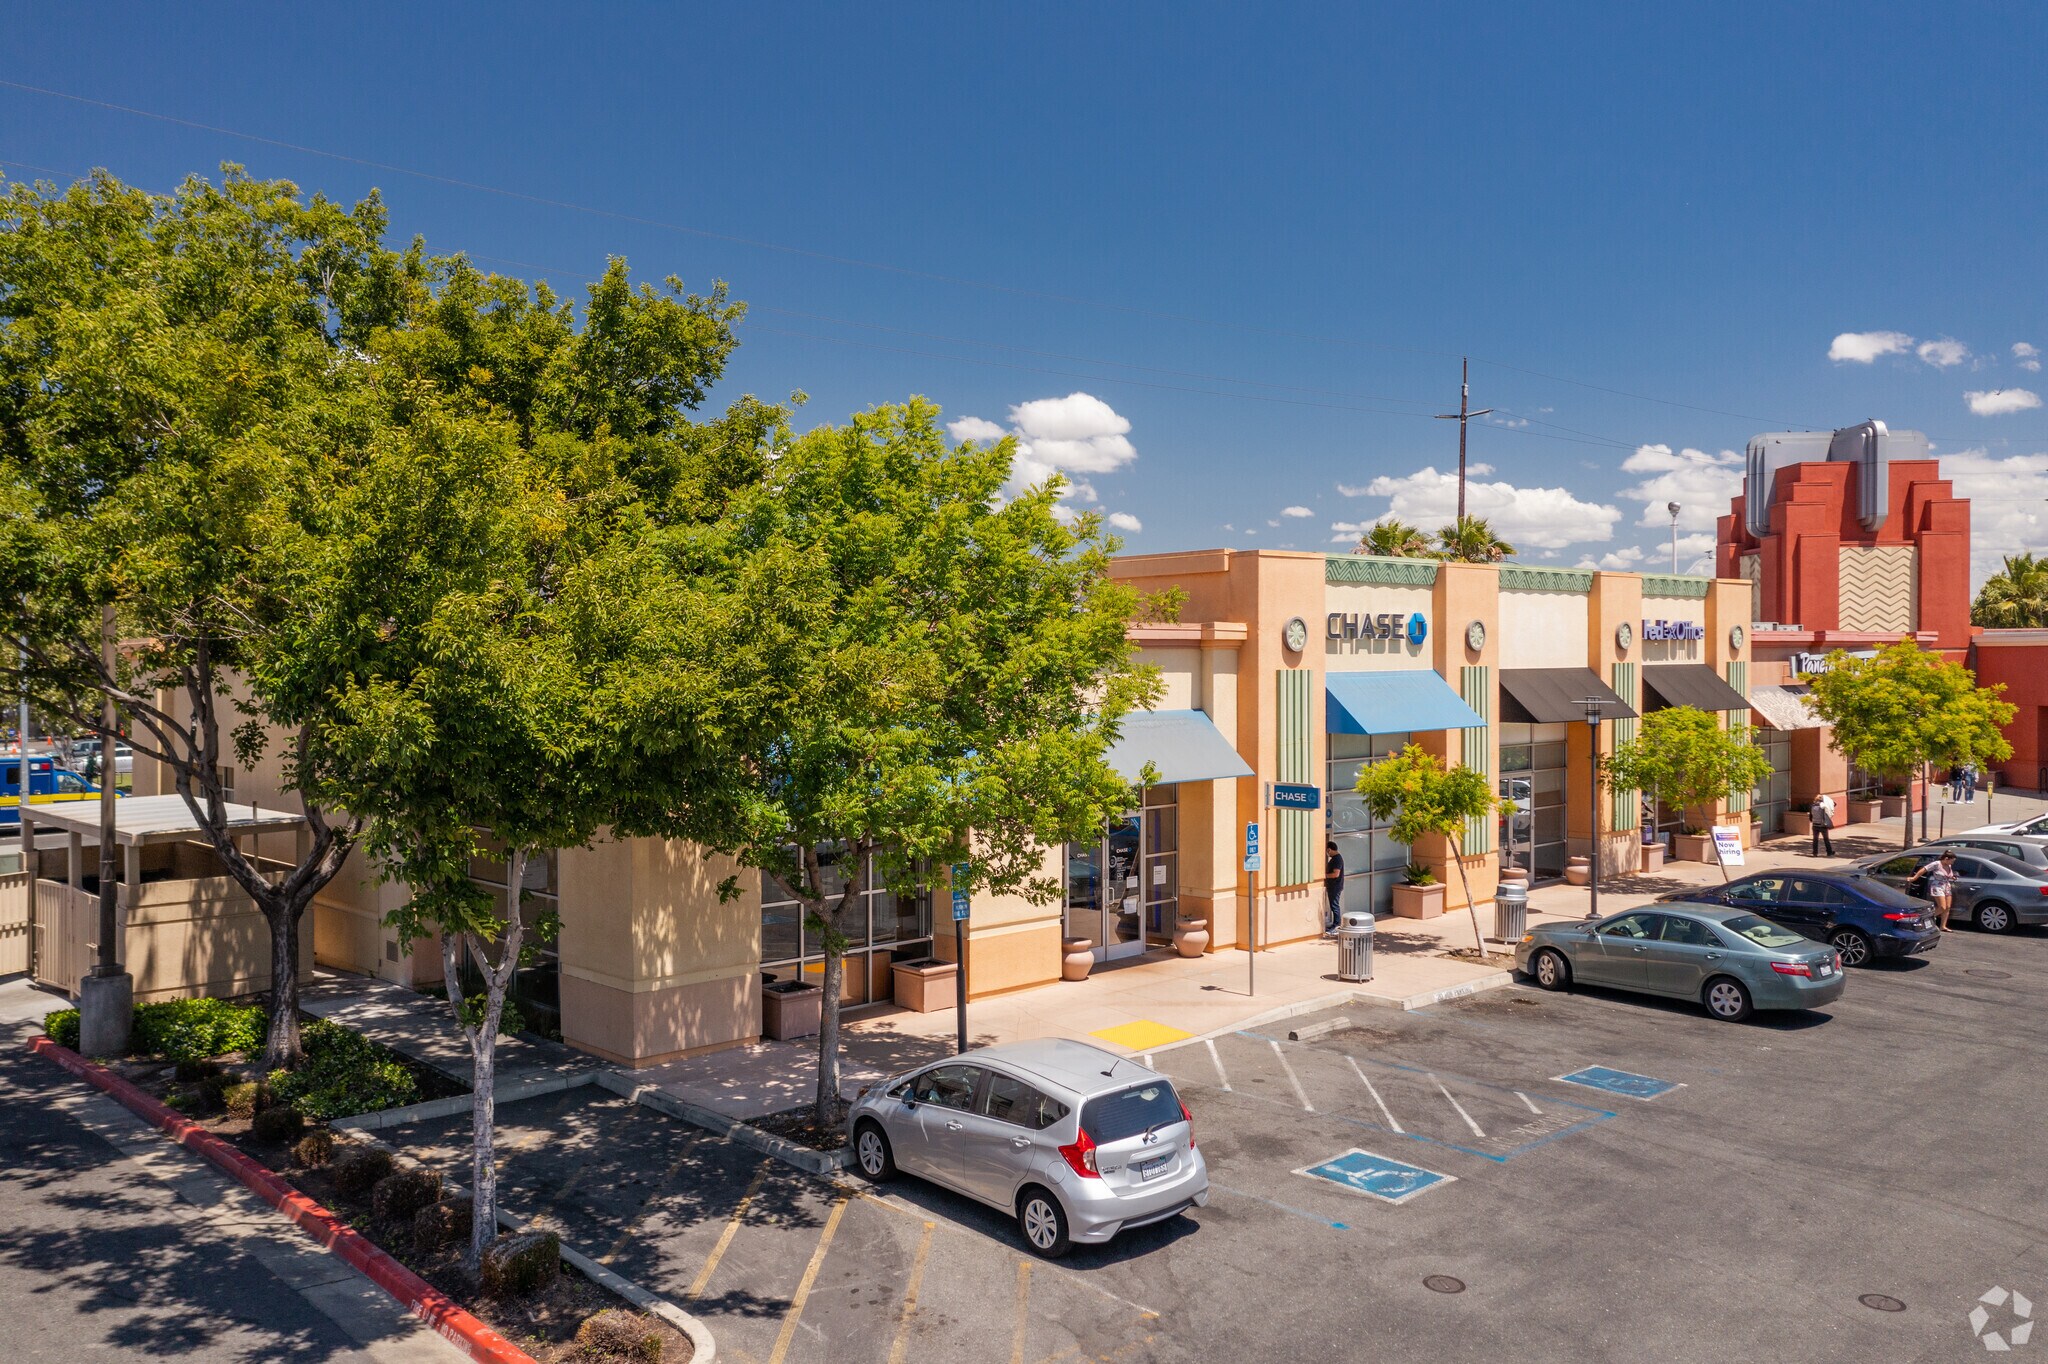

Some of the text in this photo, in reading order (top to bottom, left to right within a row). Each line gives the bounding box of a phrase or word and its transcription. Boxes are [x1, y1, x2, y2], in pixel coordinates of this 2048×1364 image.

[1327, 612, 1405, 639] CHASE
[1275, 791, 1307, 802] CHASE
[440, 1323, 449, 1337] NO
[448, 1328, 473, 1356] PARKING
